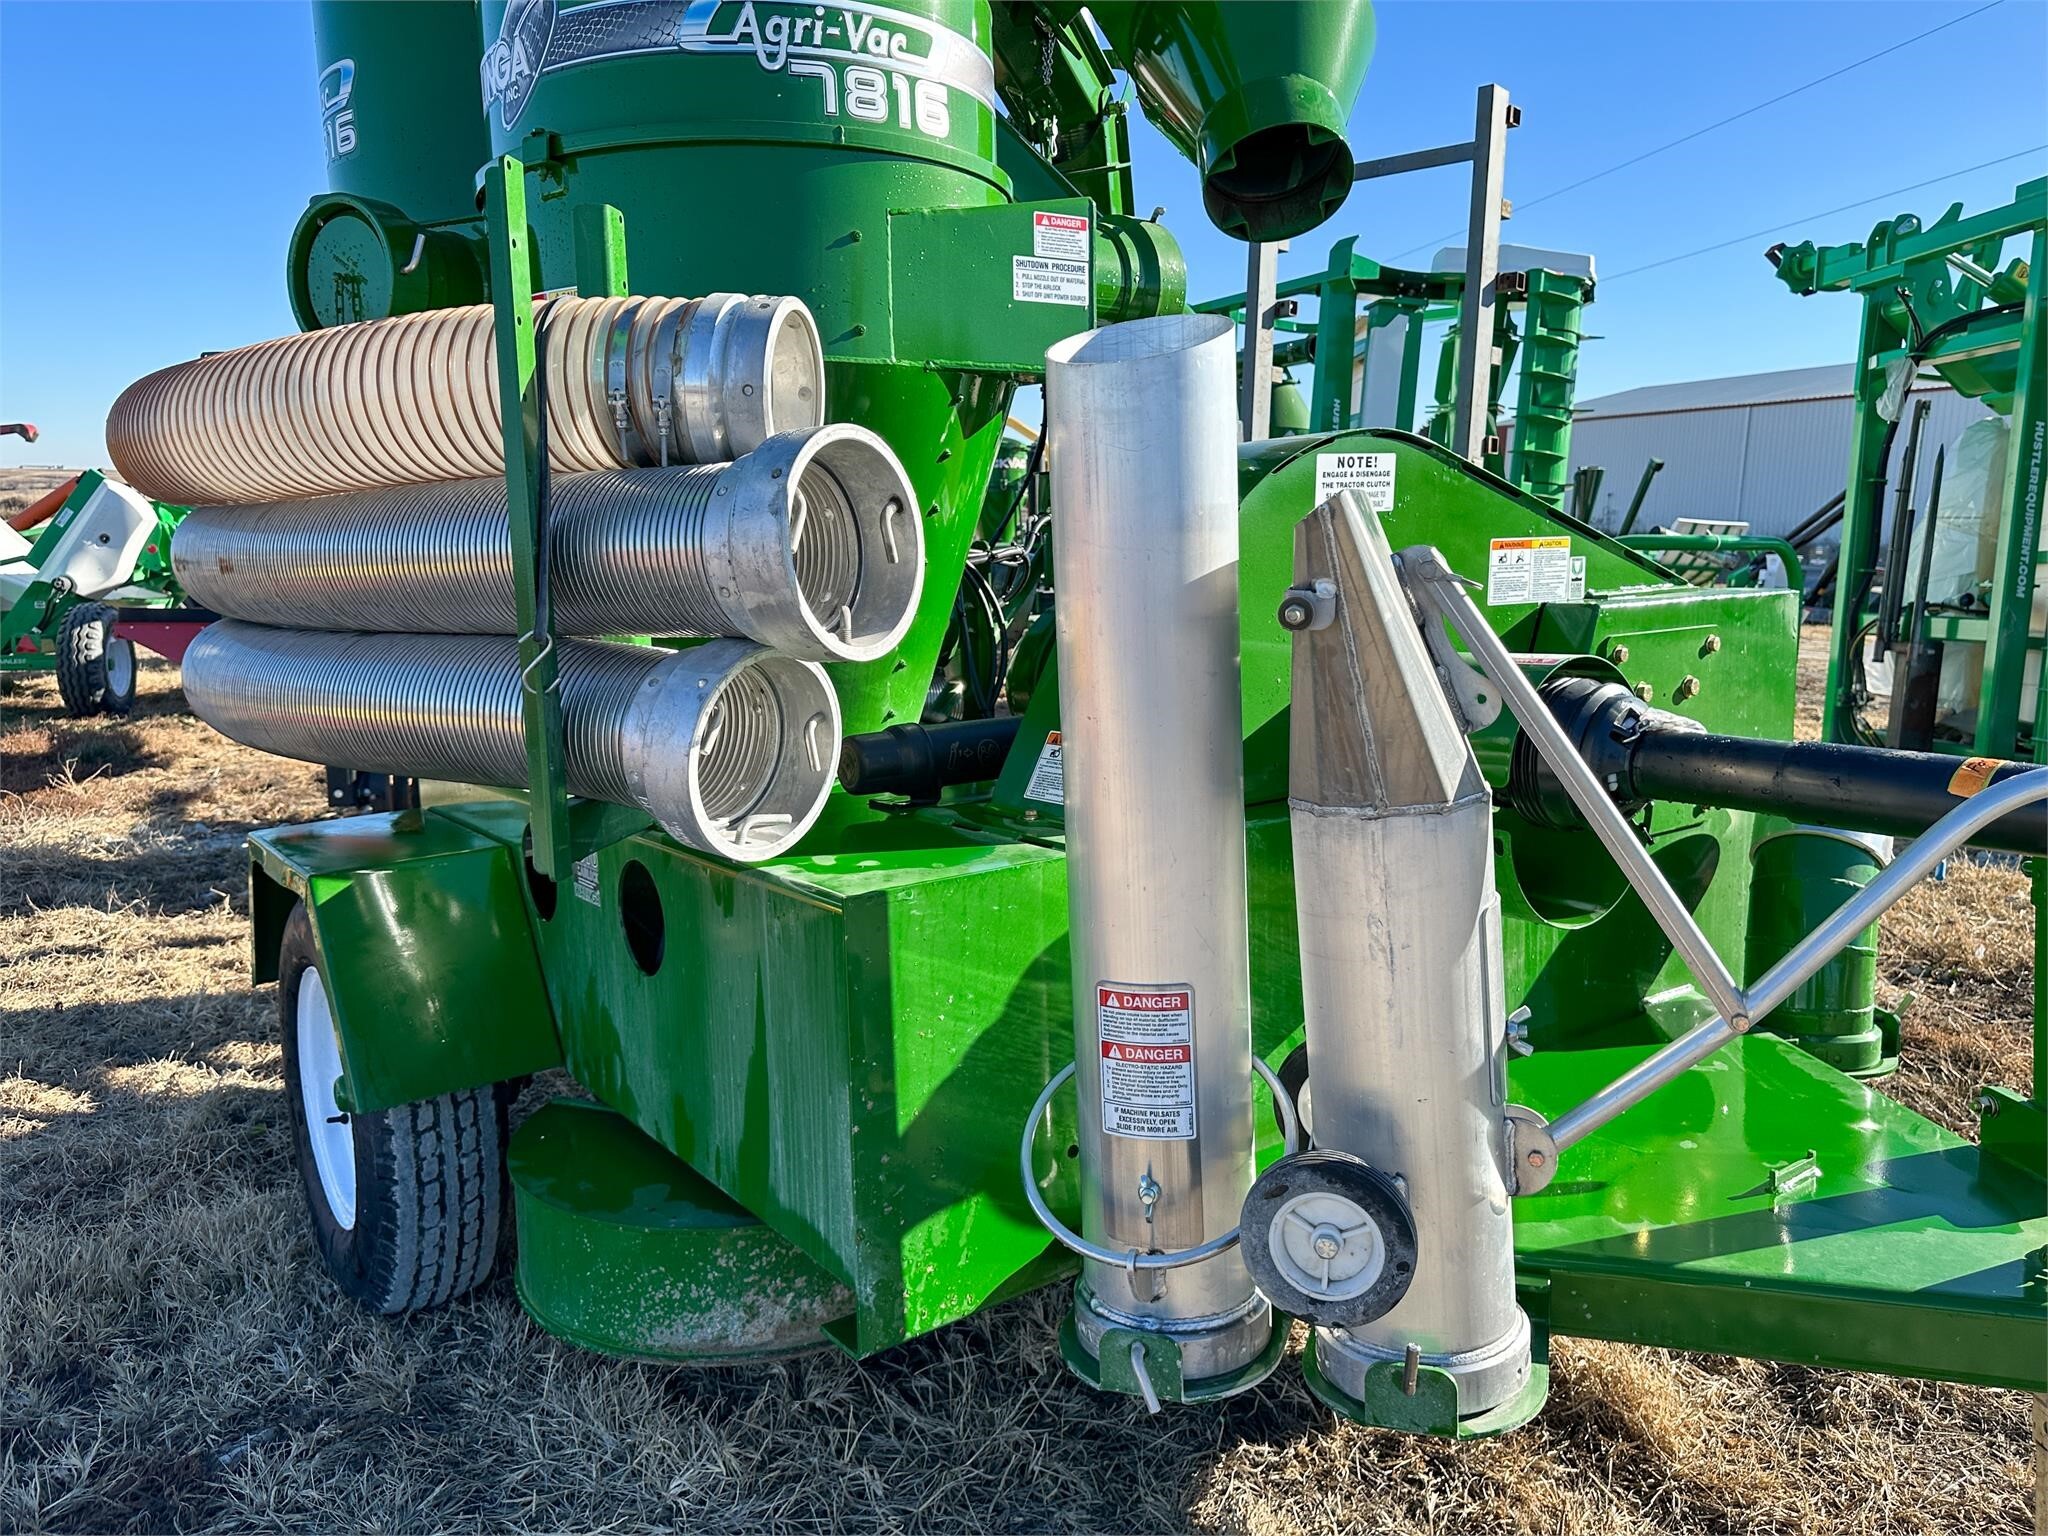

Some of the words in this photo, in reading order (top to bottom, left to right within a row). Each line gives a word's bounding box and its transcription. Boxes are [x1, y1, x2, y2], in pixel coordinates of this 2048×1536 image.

[730, 2, 910, 71] Agri-Vac
[505, 86, 521, 103] INC.
[788, 58, 950, 139] 7816
[1051, 217, 1081, 228] DANGER
[1016, 259, 1048, 269] SHUTDOWN
[1052, 263, 1086, 273] PROCEDURE
[1066, 277, 1086, 285] MATERIAL
[1337, 456, 1378, 468] NOTE!
[2015, 421, 2045, 598] HUSTLEREQUIPMENT.COM
[1124, 996, 1181, 1008] DANGER
[1126, 1047, 1183, 1060] DANGER
[1116, 1062, 1159, 1070] ELECTRO-STATIC
[1121, 1108, 1147, 1117] MACHINE
